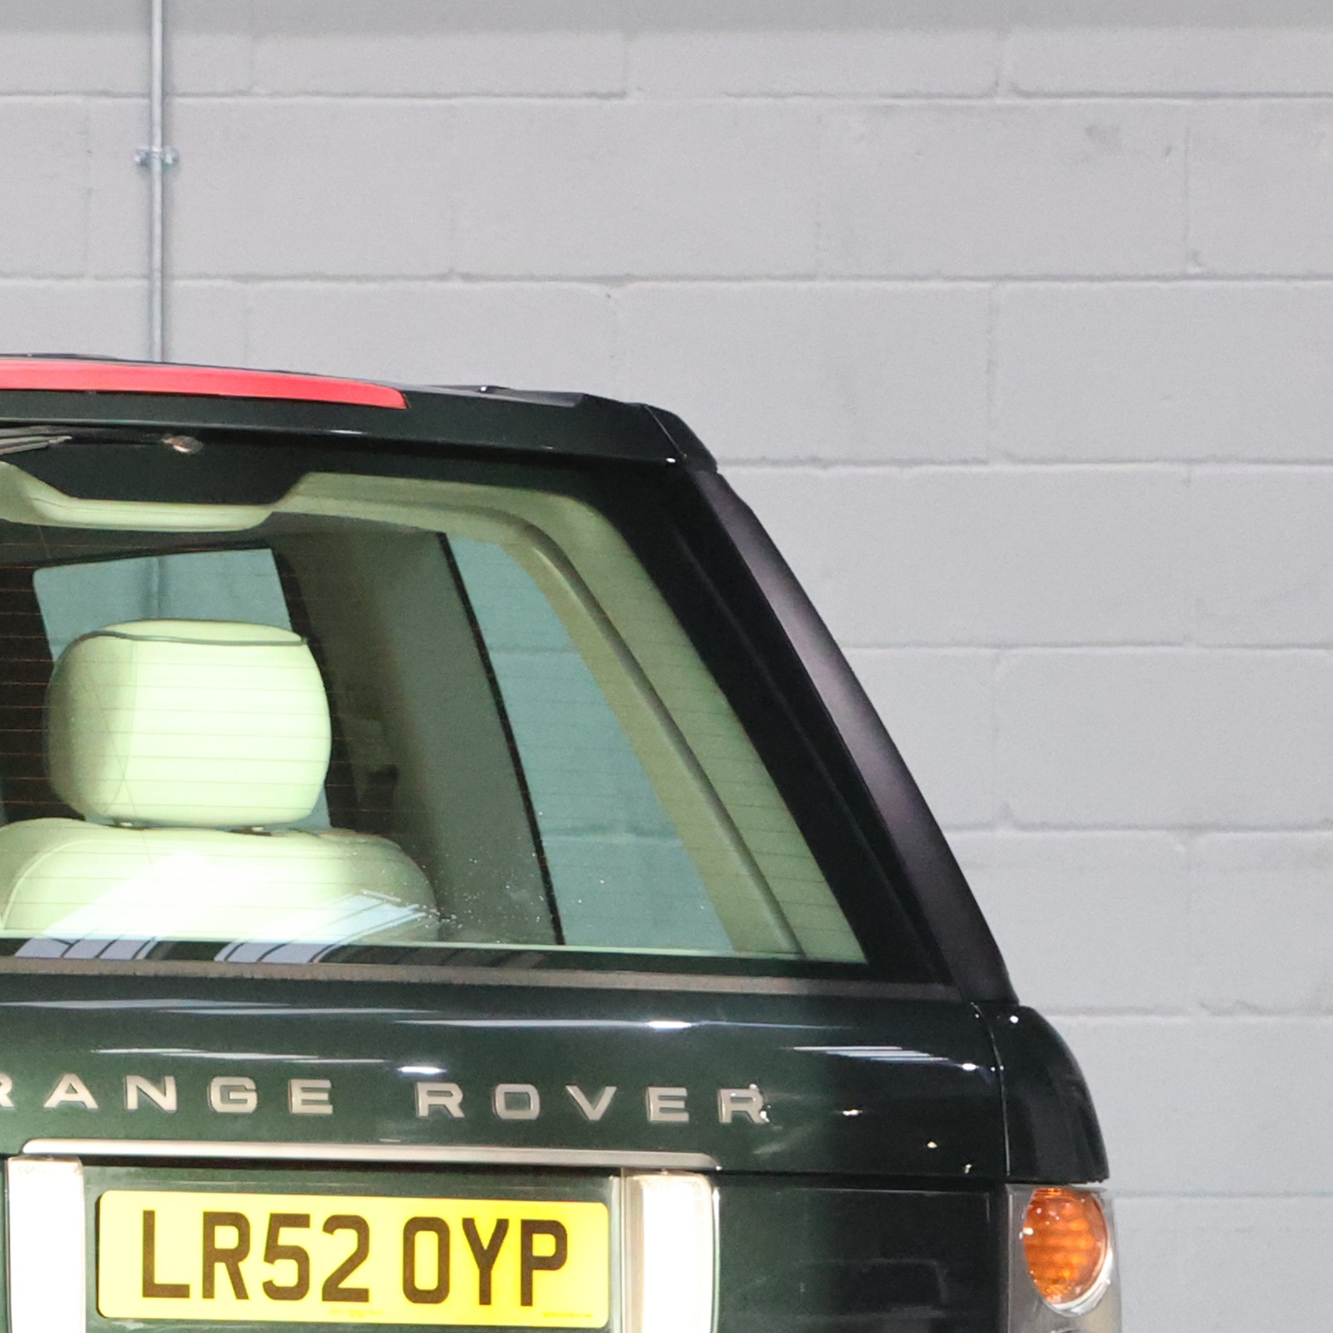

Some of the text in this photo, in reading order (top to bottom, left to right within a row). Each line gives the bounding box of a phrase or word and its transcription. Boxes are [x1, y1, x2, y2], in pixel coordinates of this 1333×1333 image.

[415, 1081, 768, 1125] ROVER
[141, 1209, 569, 1308] LR52 OYP
